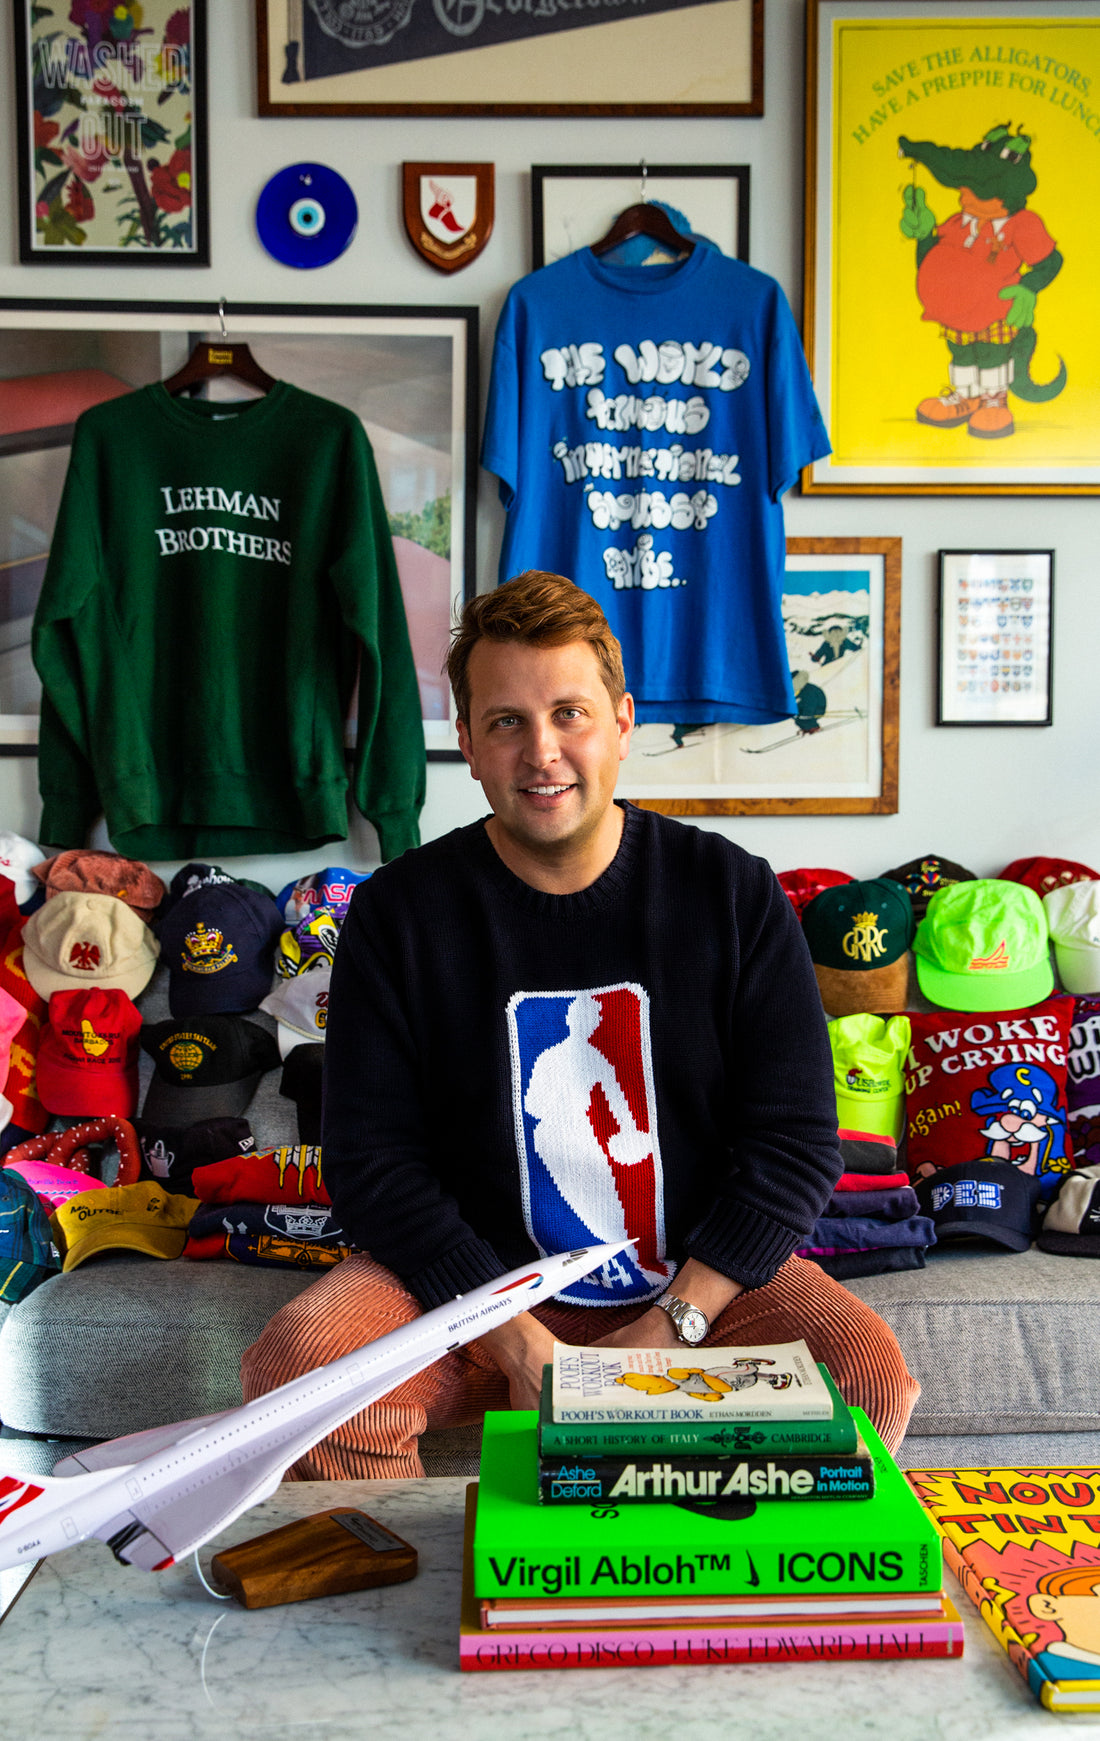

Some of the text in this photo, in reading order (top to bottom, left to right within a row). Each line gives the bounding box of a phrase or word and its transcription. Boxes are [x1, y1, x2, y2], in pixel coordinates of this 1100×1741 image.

[38, 39, 186, 92] WASHED
[872, 59, 921, 97] SAVE
[921, 47, 964, 72] THE
[852, 96, 903, 145] HAVE
[906, 88, 920, 106] A
[922, 70, 1004, 98] PREPPIE
[1009, 72, 1046, 98] FOR
[79, 111, 148, 160] OUT
[160, 486, 281, 522] LEHMAN
[155, 527, 292, 565] BROTHERS
[924, 1015, 1061, 1054] WOKE
[905, 1065, 933, 1095] UP
[941, 1043, 1067, 1075] CRYING
[909, 1100, 962, 1138] Again!
[447, 1297, 512, 1333] BRITISH AIRWAYS
[580, 1351, 602, 1397] WORKOUT
[561, 1410, 604, 1421] POOH'S
[606, 1409, 669, 1420] WORKOUT
[671, 1408, 703, 1420] BOOK
[554, 1433, 832, 1445] A SHORT HISTORY OF ITALY CAMBRIDGE
[551, 1482, 602, 1498] Deford
[557, 1465, 596, 1481] Ashe
[608, 1462, 814, 1497] Arthur Ashe
[817, 1480, 869, 1491] in Motion
[820, 1466, 863, 1479] Portrait
[951, 1481, 1100, 1507] NOU
[489, 1556, 580, 1594] Virgil
[778, 1551, 903, 1583] ICONS
[919, 1543, 928, 1587] TASCHEN
[476, 1642, 568, 1665] GRECO
[577, 1641, 654, 1664] DISCO
[672, 1637, 740, 1660] LUKE
[748, 1634, 856, 1658] EDWARD
[866, 1632, 934, 1654] HALL
